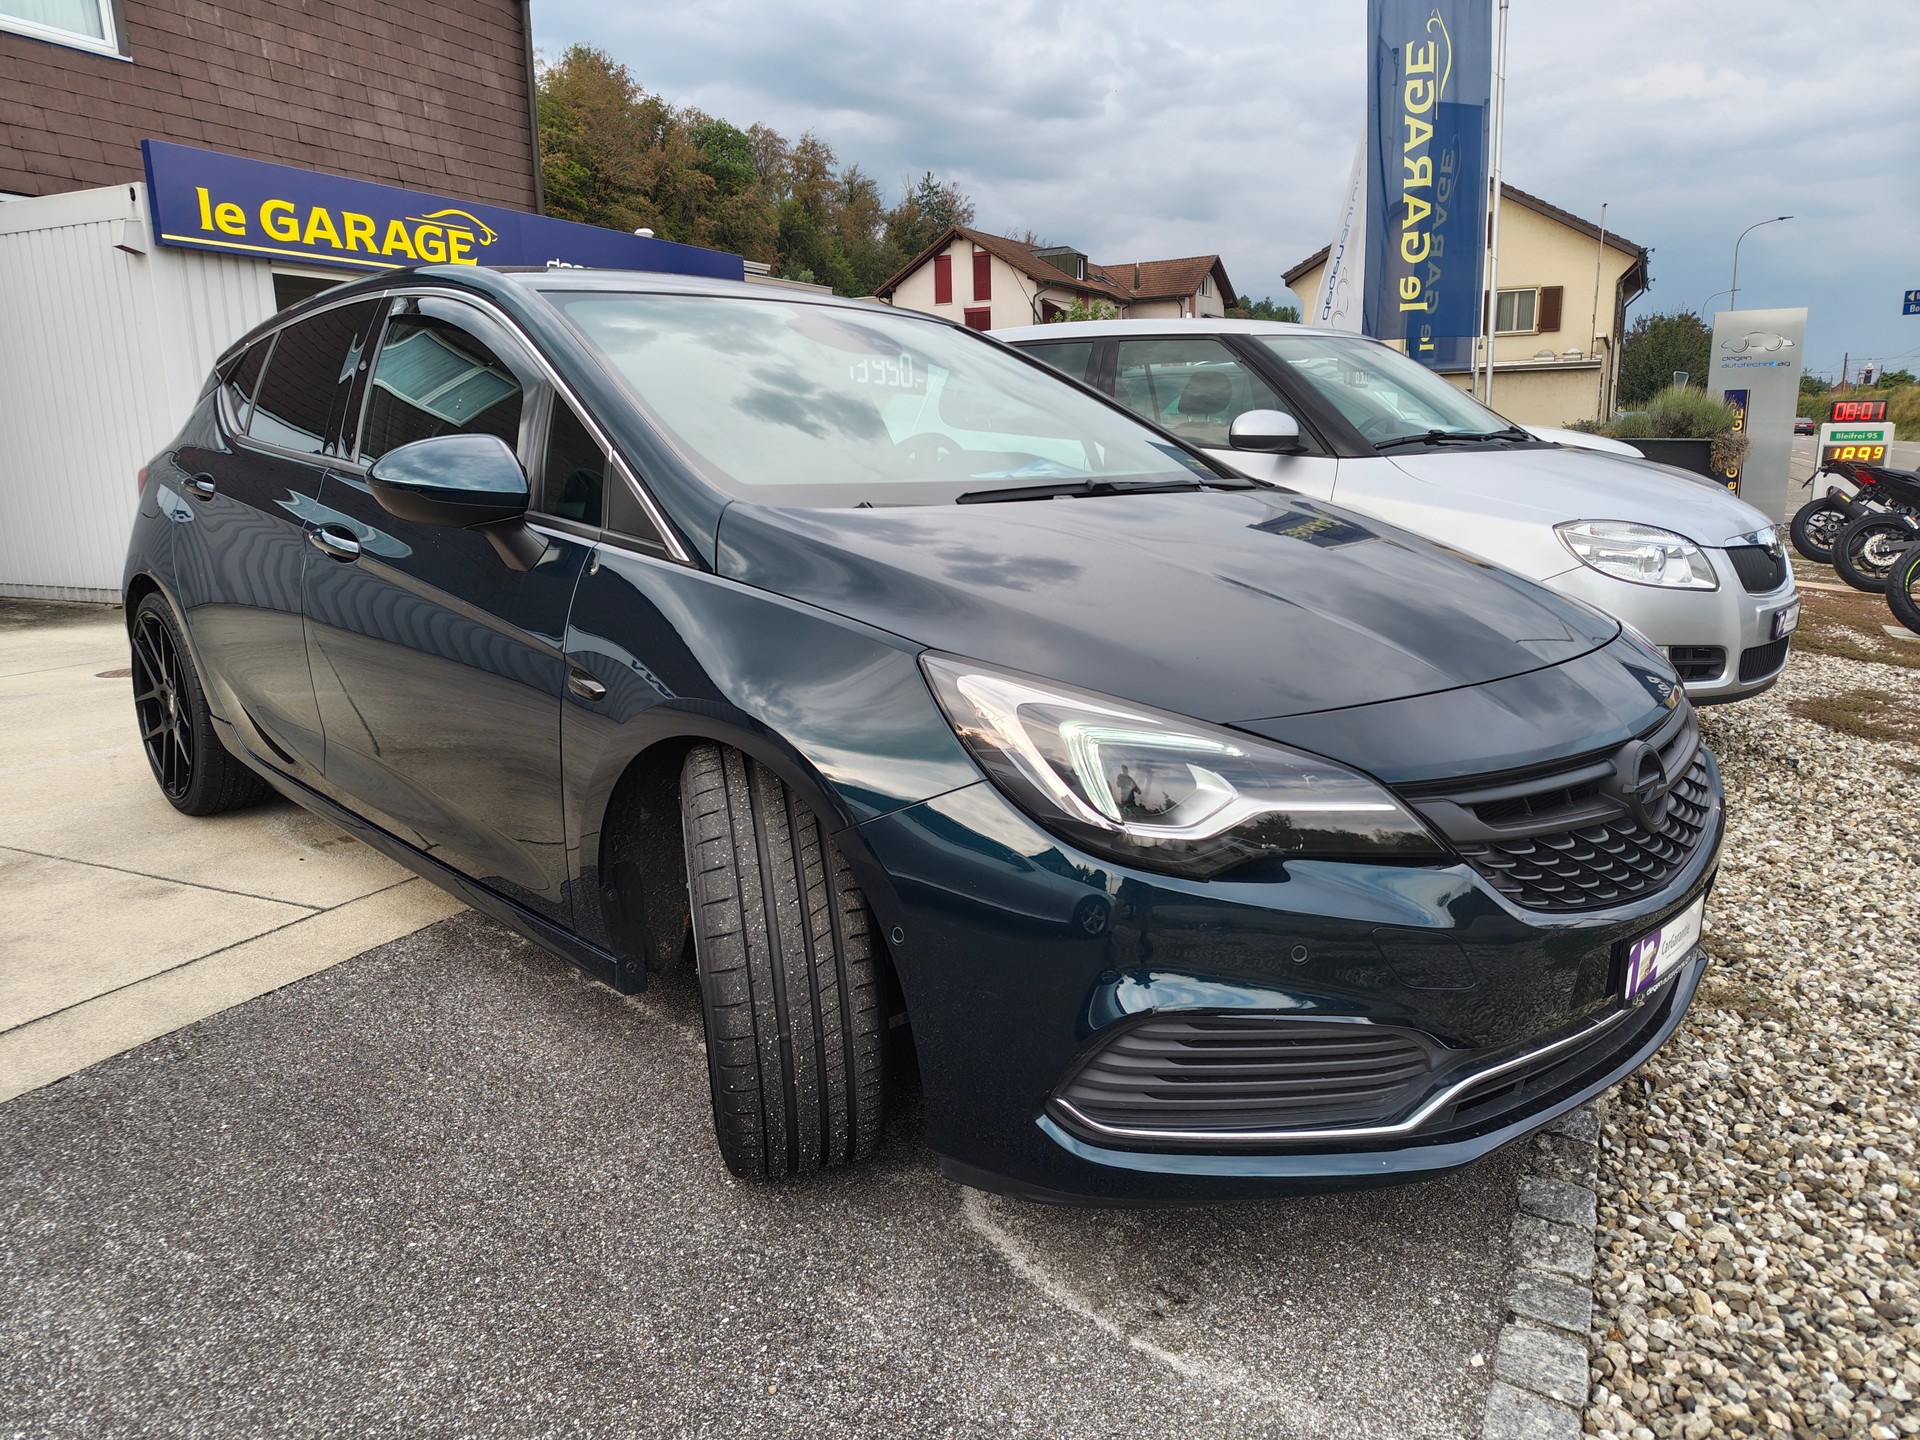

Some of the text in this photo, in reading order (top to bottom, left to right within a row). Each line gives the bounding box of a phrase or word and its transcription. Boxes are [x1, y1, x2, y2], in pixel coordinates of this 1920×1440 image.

[195, 186, 479, 267] le GARAGE
[1833, 402, 1886, 421] 08:01
